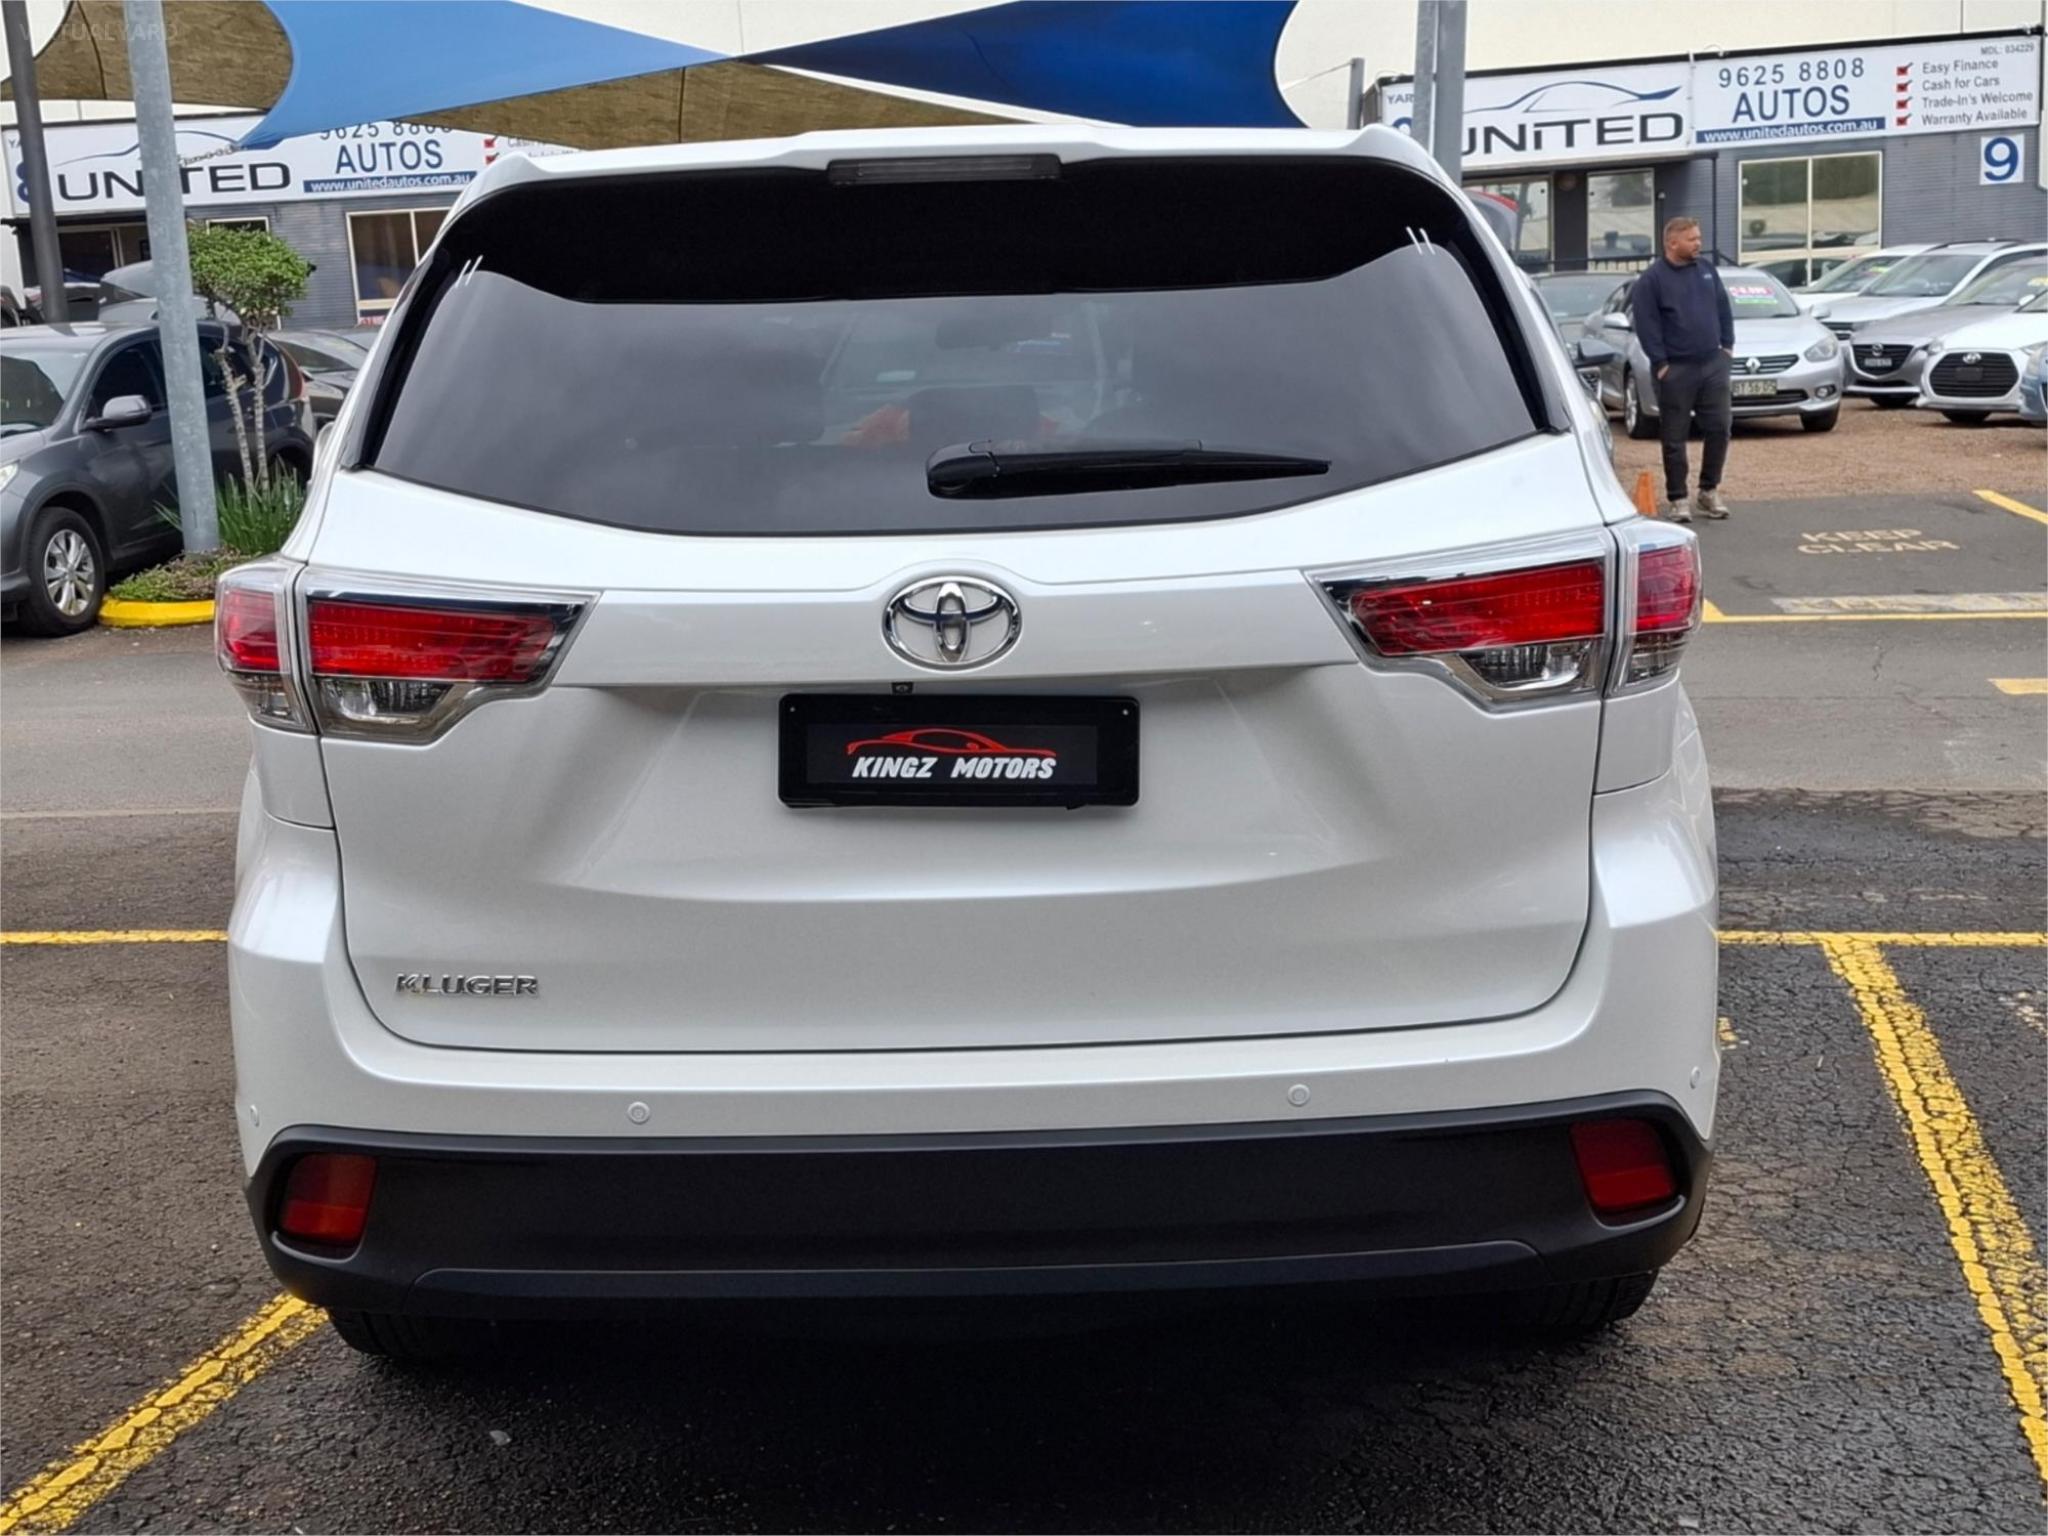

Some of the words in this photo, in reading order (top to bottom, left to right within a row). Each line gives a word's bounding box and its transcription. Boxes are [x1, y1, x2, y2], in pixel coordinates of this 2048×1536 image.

[1718, 63, 1784, 88] 9625
[1799, 57, 1864, 82] 8808
[1922, 62, 1950, 75] Easy
[1953, 59, 1998, 72] Finance
[1922, 79, 1951, 91] Cash
[1955, 77, 1971, 88] for
[1974, 75, 2000, 87] Cars
[1732, 84, 1850, 123] AUTOS
[1981, 91, 2033, 104] Welcome
[1921, 112, 1972, 126] Warranty
[1975, 107, 2027, 121] Available
[1703, 119, 1877, 143] www.unitedautos.com.au
[335, 139, 443, 175] AUTOS
[1984, 137, 2019, 182] 9
[310, 174, 471, 193] www.unitedautos.com.au
[1801, 528, 1922, 543] KEEP
[1797, 540, 1961, 554] CLEAR
[852, 757, 938, 778] KINGZ
[950, 757, 1056, 779] MOTORS
[395, 972, 538, 996] KLUGER
